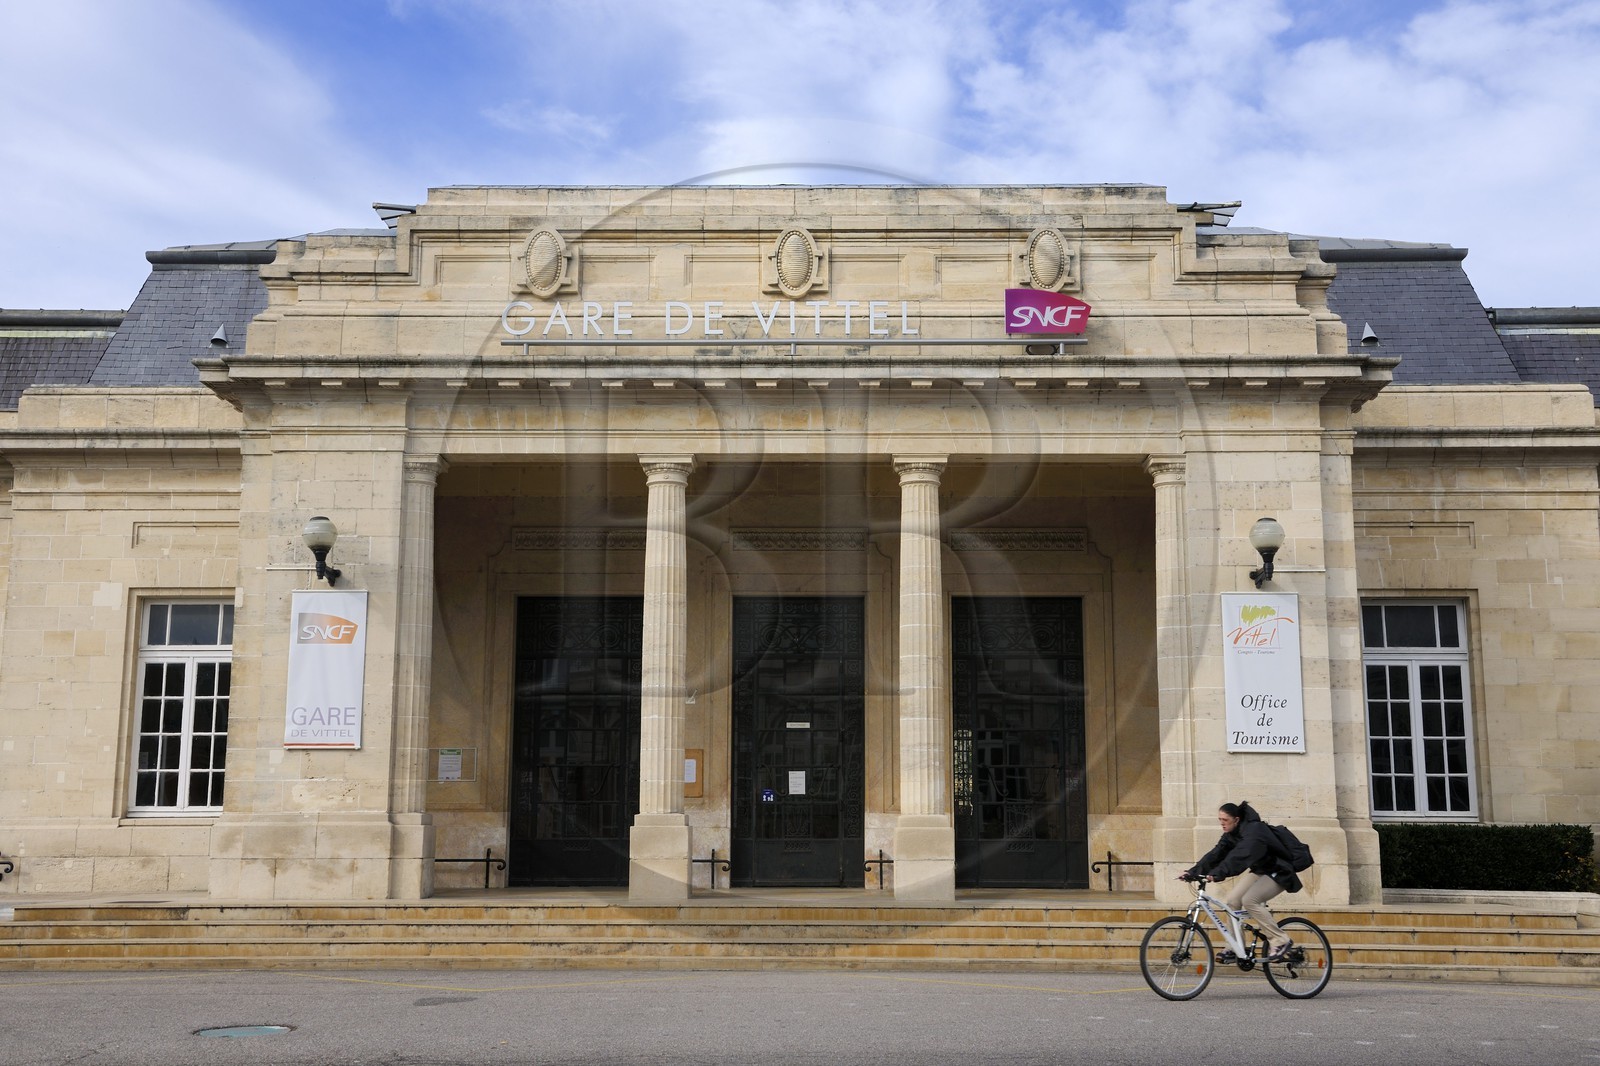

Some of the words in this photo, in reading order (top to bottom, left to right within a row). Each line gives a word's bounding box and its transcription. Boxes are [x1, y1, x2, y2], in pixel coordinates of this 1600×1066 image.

[501, 301, 633, 336] GARE
[665, 301, 724, 335] DE
[752, 301, 918, 335] VITTEL
[1009, 305, 1086, 328] SNCF
[300, 624, 355, 640] SNCF
[1240, 694, 1288, 711] Office
[291, 706, 356, 726] GARE
[1256, 713, 1273, 726] de
[290, 729, 308, 738] DE
[312, 729, 354, 738] VITTEL
[1232, 731, 1299, 745] Tourisme
